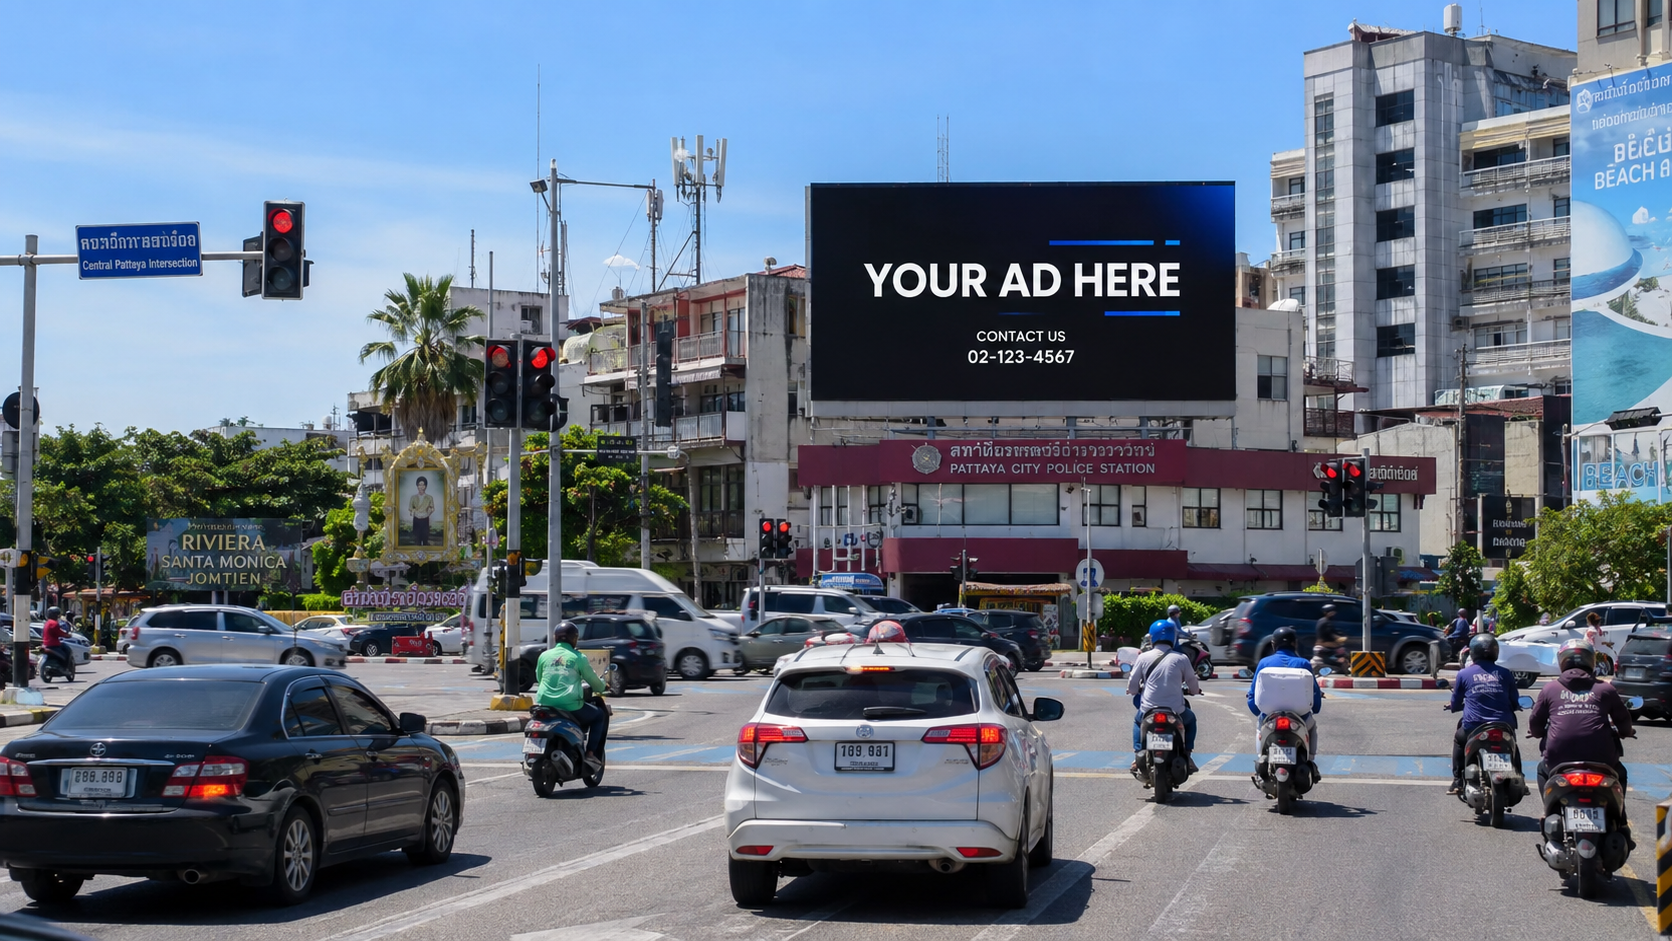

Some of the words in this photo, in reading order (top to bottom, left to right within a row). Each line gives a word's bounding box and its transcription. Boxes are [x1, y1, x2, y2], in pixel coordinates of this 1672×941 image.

[82, 259, 113, 271] Central
[149, 257, 198, 269] Intersection
[864, 262, 987, 298] YOUR
[999, 262, 1062, 298] AD
[1074, 262, 1181, 298] HERE
[976, 330, 1044, 343] CONTACT
[1048, 330, 1066, 343] US
[967, 350, 1075, 365] 02-123-4567
[950, 463, 1006, 474] PATTAYA
[1011, 463, 1041, 474] CITY
[1046, 463, 1094, 474] POLICE
[1100, 463, 1155, 474] STATION
[1584, 460, 1659, 488] BEACH
[182, 534, 266, 551] RIVIERA
[161, 555, 214, 569] SANTA
[219, 555, 287, 569] MONICA
[186, 572, 261, 585] JOMTIEN
